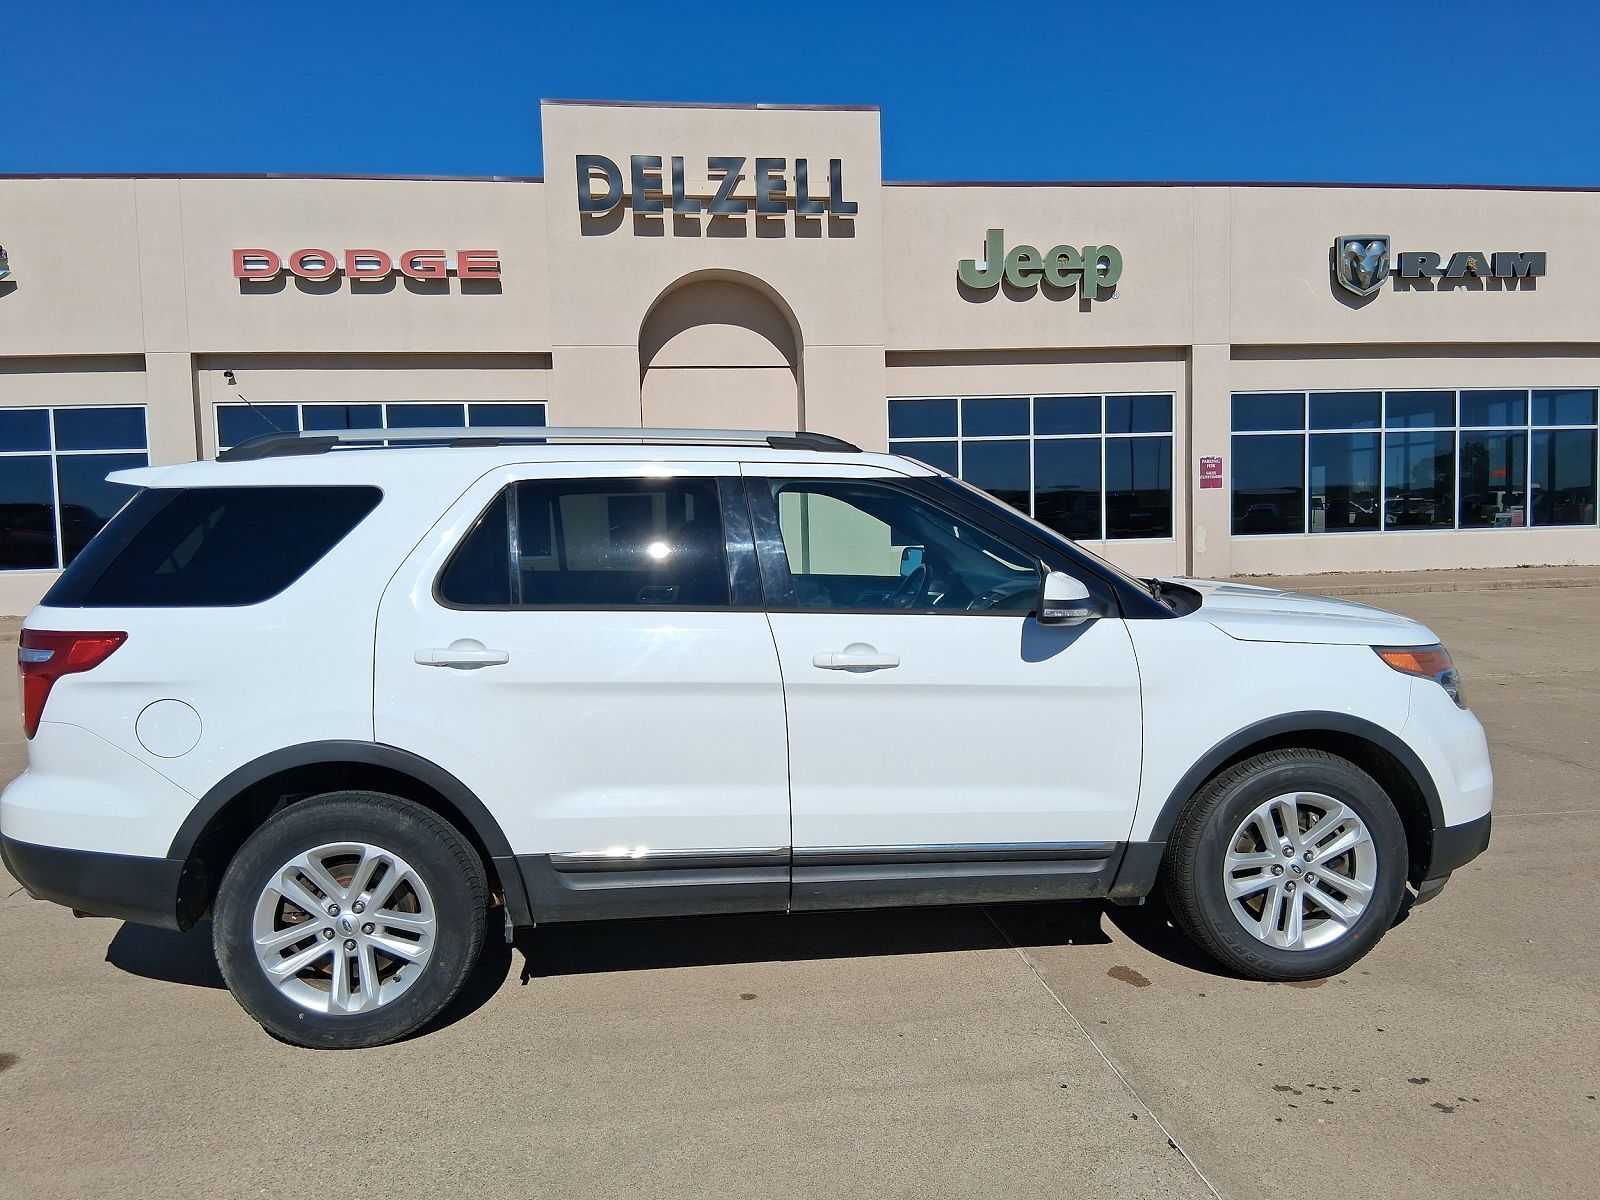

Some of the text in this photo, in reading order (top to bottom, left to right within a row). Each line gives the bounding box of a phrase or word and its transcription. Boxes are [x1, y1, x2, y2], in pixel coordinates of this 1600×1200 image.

[576, 154, 858, 214] DELZELL
[232, 248, 501, 279] DODGE
[959, 228, 1123, 299] Jeep
[1398, 251, 1547, 278] RAM
